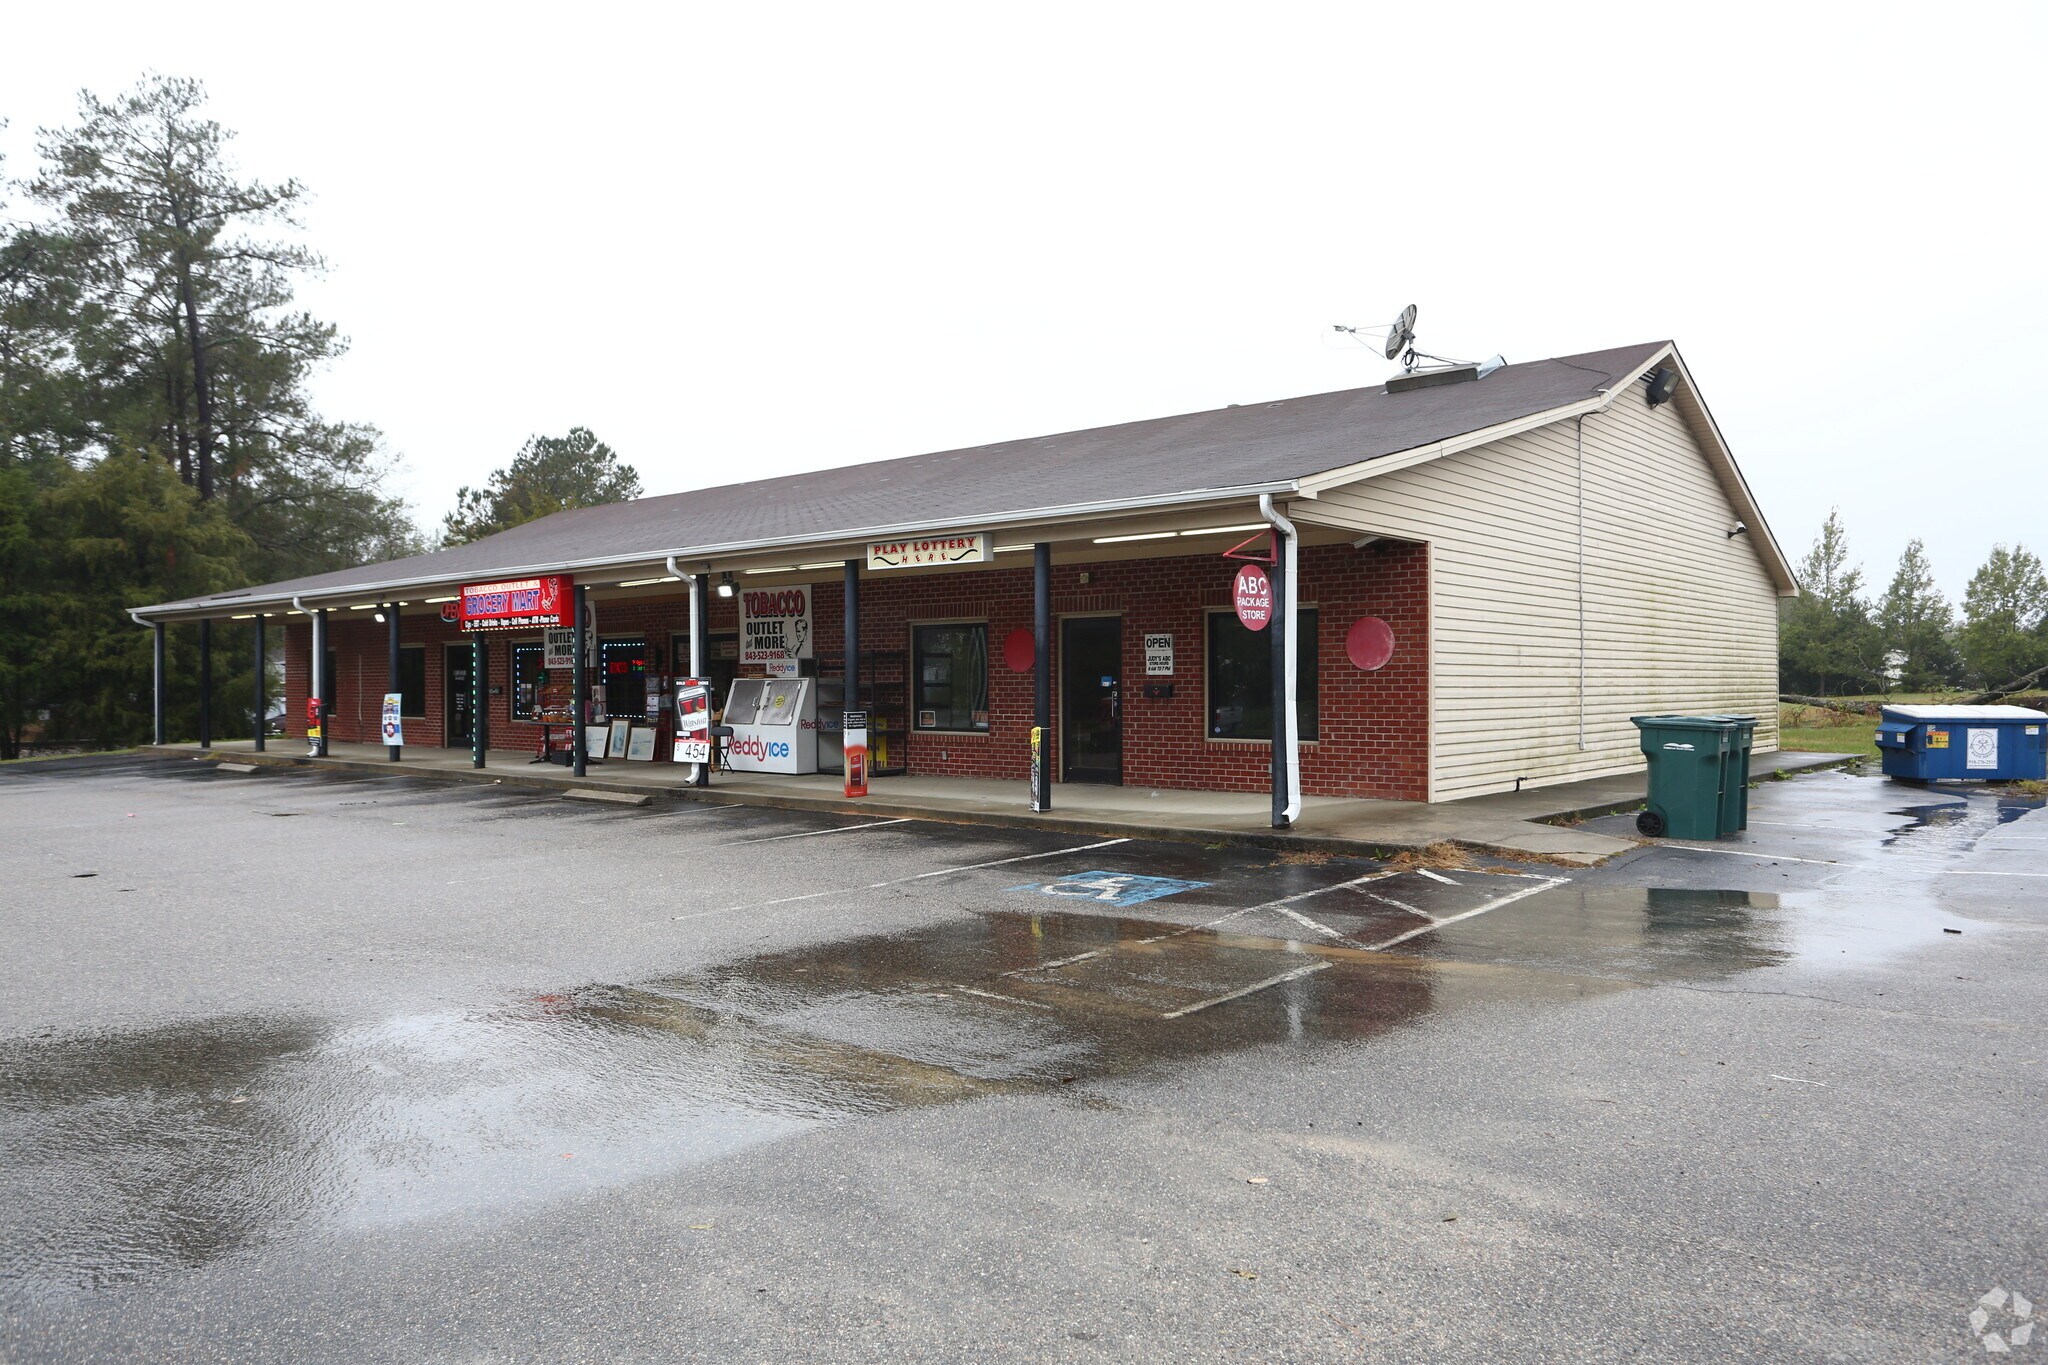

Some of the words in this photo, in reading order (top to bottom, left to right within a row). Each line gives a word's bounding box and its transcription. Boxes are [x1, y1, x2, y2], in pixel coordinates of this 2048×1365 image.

[874, 543, 909, 556] PLAY
[913, 536, 977, 552] LOTTERY
[902, 552, 948, 564] HERE
[465, 585, 497, 594] TOBACCO
[502, 582, 529, 590] OUTLET
[532, 581, 539, 589] &
[1238, 576, 1267, 595] ABC
[465, 593, 510, 616] GROCERY
[512, 589, 540, 612] MART
[743, 590, 806, 619] TOBACCO
[1237, 596, 1270, 608] PACKAGE
[1242, 609, 1266, 620] STORE
[746, 621, 785, 635] OUTLET
[754, 636, 786, 650] MORE
[1146, 637, 1171, 649] OPEN
[745, 650, 785, 660] 843-523-9168
[682, 717, 707, 729] Winston
